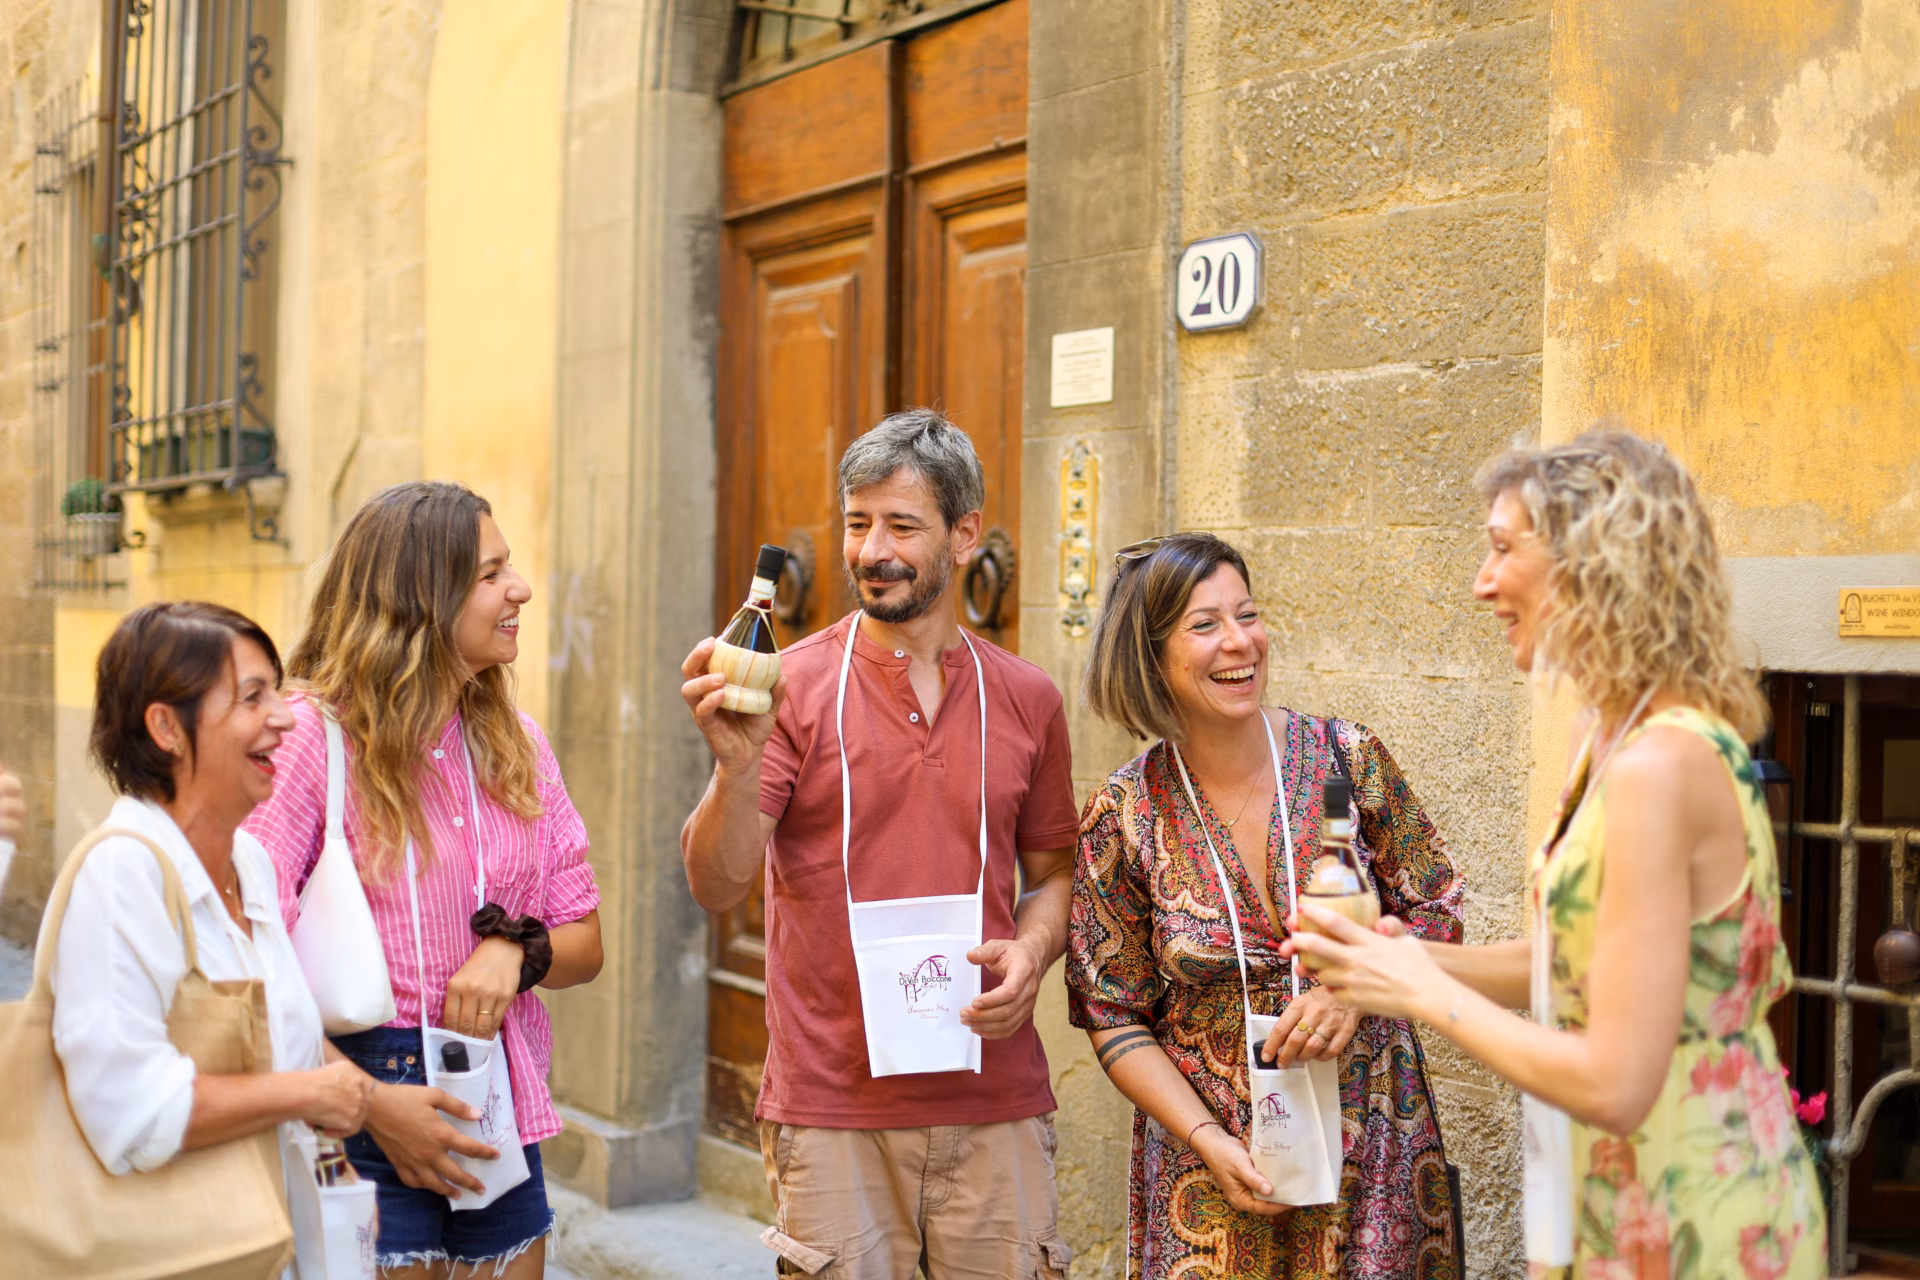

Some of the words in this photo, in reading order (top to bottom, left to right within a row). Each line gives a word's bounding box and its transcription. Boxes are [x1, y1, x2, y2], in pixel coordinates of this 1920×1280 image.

[1190, 251, 1241, 316] 20
[1862, 594, 1901, 603] BUCHETTA
[1866, 608, 1889, 617] WINE
[921, 974, 952, 984] Boccone
[935, 1002, 950, 1015] Shop
[1260, 1112, 1292, 1122] Boccone
[1274, 1141, 1292, 1152] Shop
